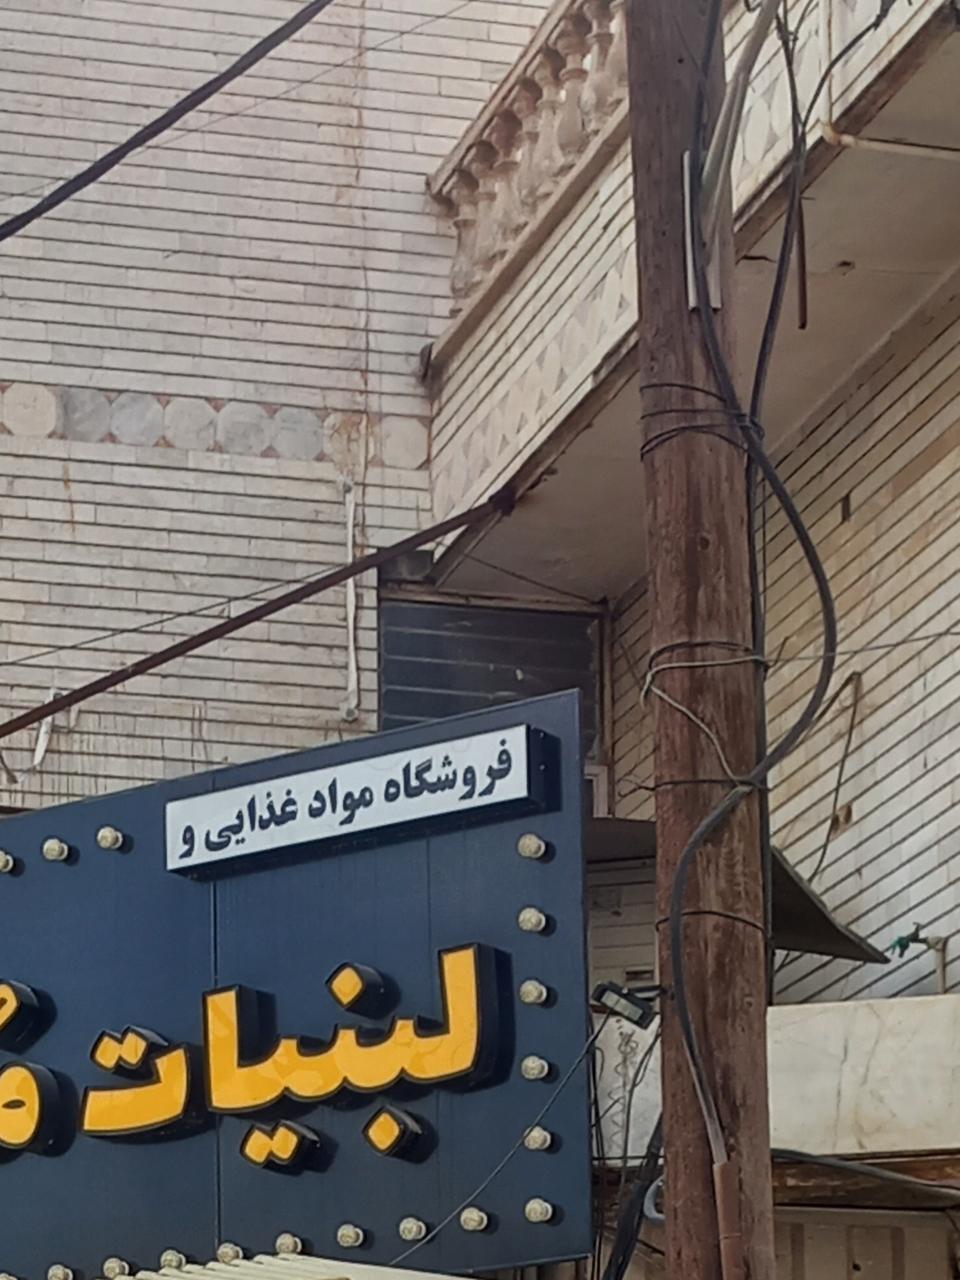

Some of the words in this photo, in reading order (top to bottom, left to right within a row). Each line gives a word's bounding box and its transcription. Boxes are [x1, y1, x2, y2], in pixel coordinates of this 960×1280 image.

[308, 776, 374, 825] مواد
[384, 738, 514, 804] فروشگاه
[178, 823, 196, 859] و
[204, 790, 298, 852] غذایی
[81, 943, 481, 1165] لبنیات
